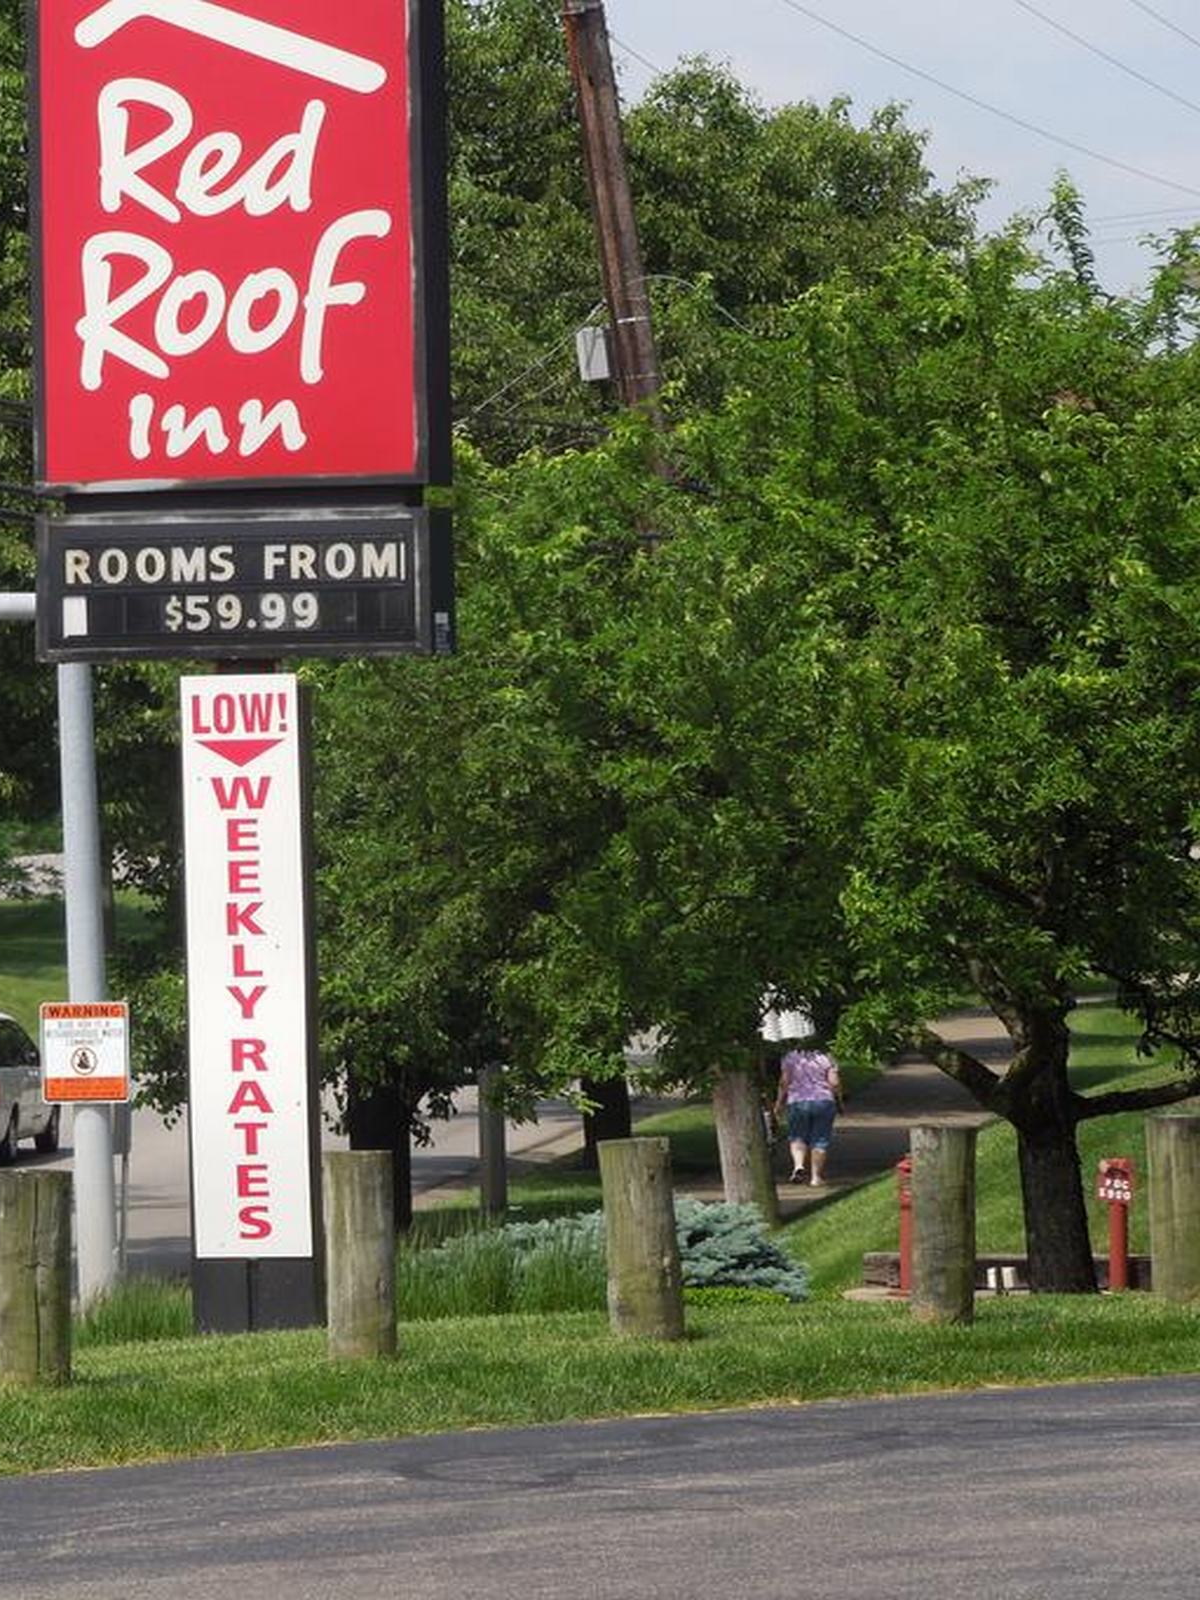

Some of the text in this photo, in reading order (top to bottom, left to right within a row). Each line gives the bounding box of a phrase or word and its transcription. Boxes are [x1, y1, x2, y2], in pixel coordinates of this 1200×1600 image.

[98, 77, 326, 223] Red
[75, 209, 392, 390] Roof
[129, 393, 307, 459] Inn
[64, 542, 397, 585] ROOMS FROM
[165, 592, 319, 632] $59.99
[191, 692, 288, 734] LOW!
[211, 776, 271, 1019] WEEKLY
[48, 1006, 120, 1018] WARNING
[227, 1038, 274, 1240] RATES
